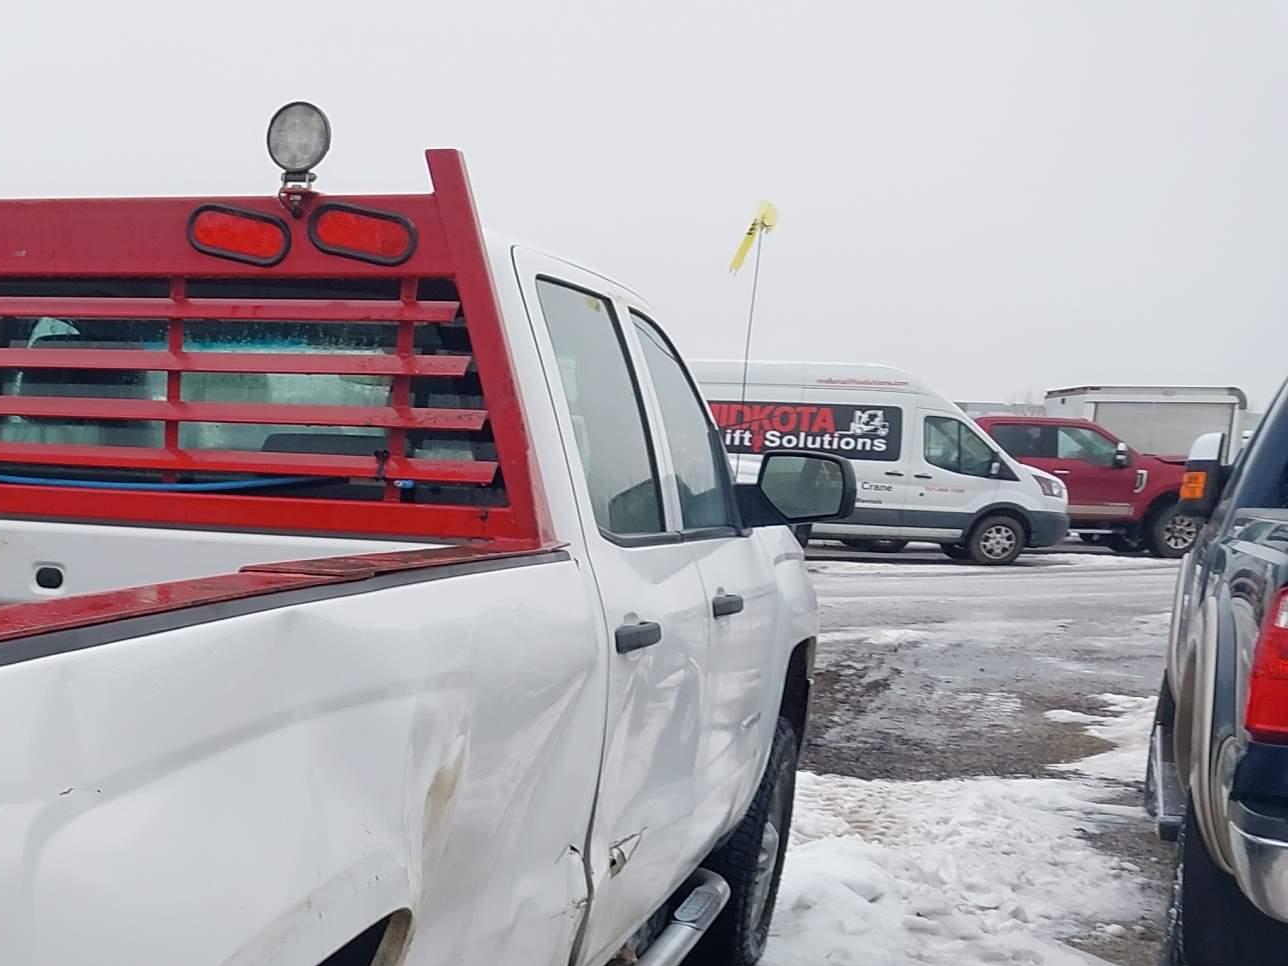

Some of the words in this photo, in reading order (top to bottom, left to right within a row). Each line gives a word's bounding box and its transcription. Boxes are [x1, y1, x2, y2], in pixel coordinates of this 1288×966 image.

[725, 429, 753, 446] ift
[764, 430, 887, 451] Solutions
[861, 481, 893, 492] Crane
